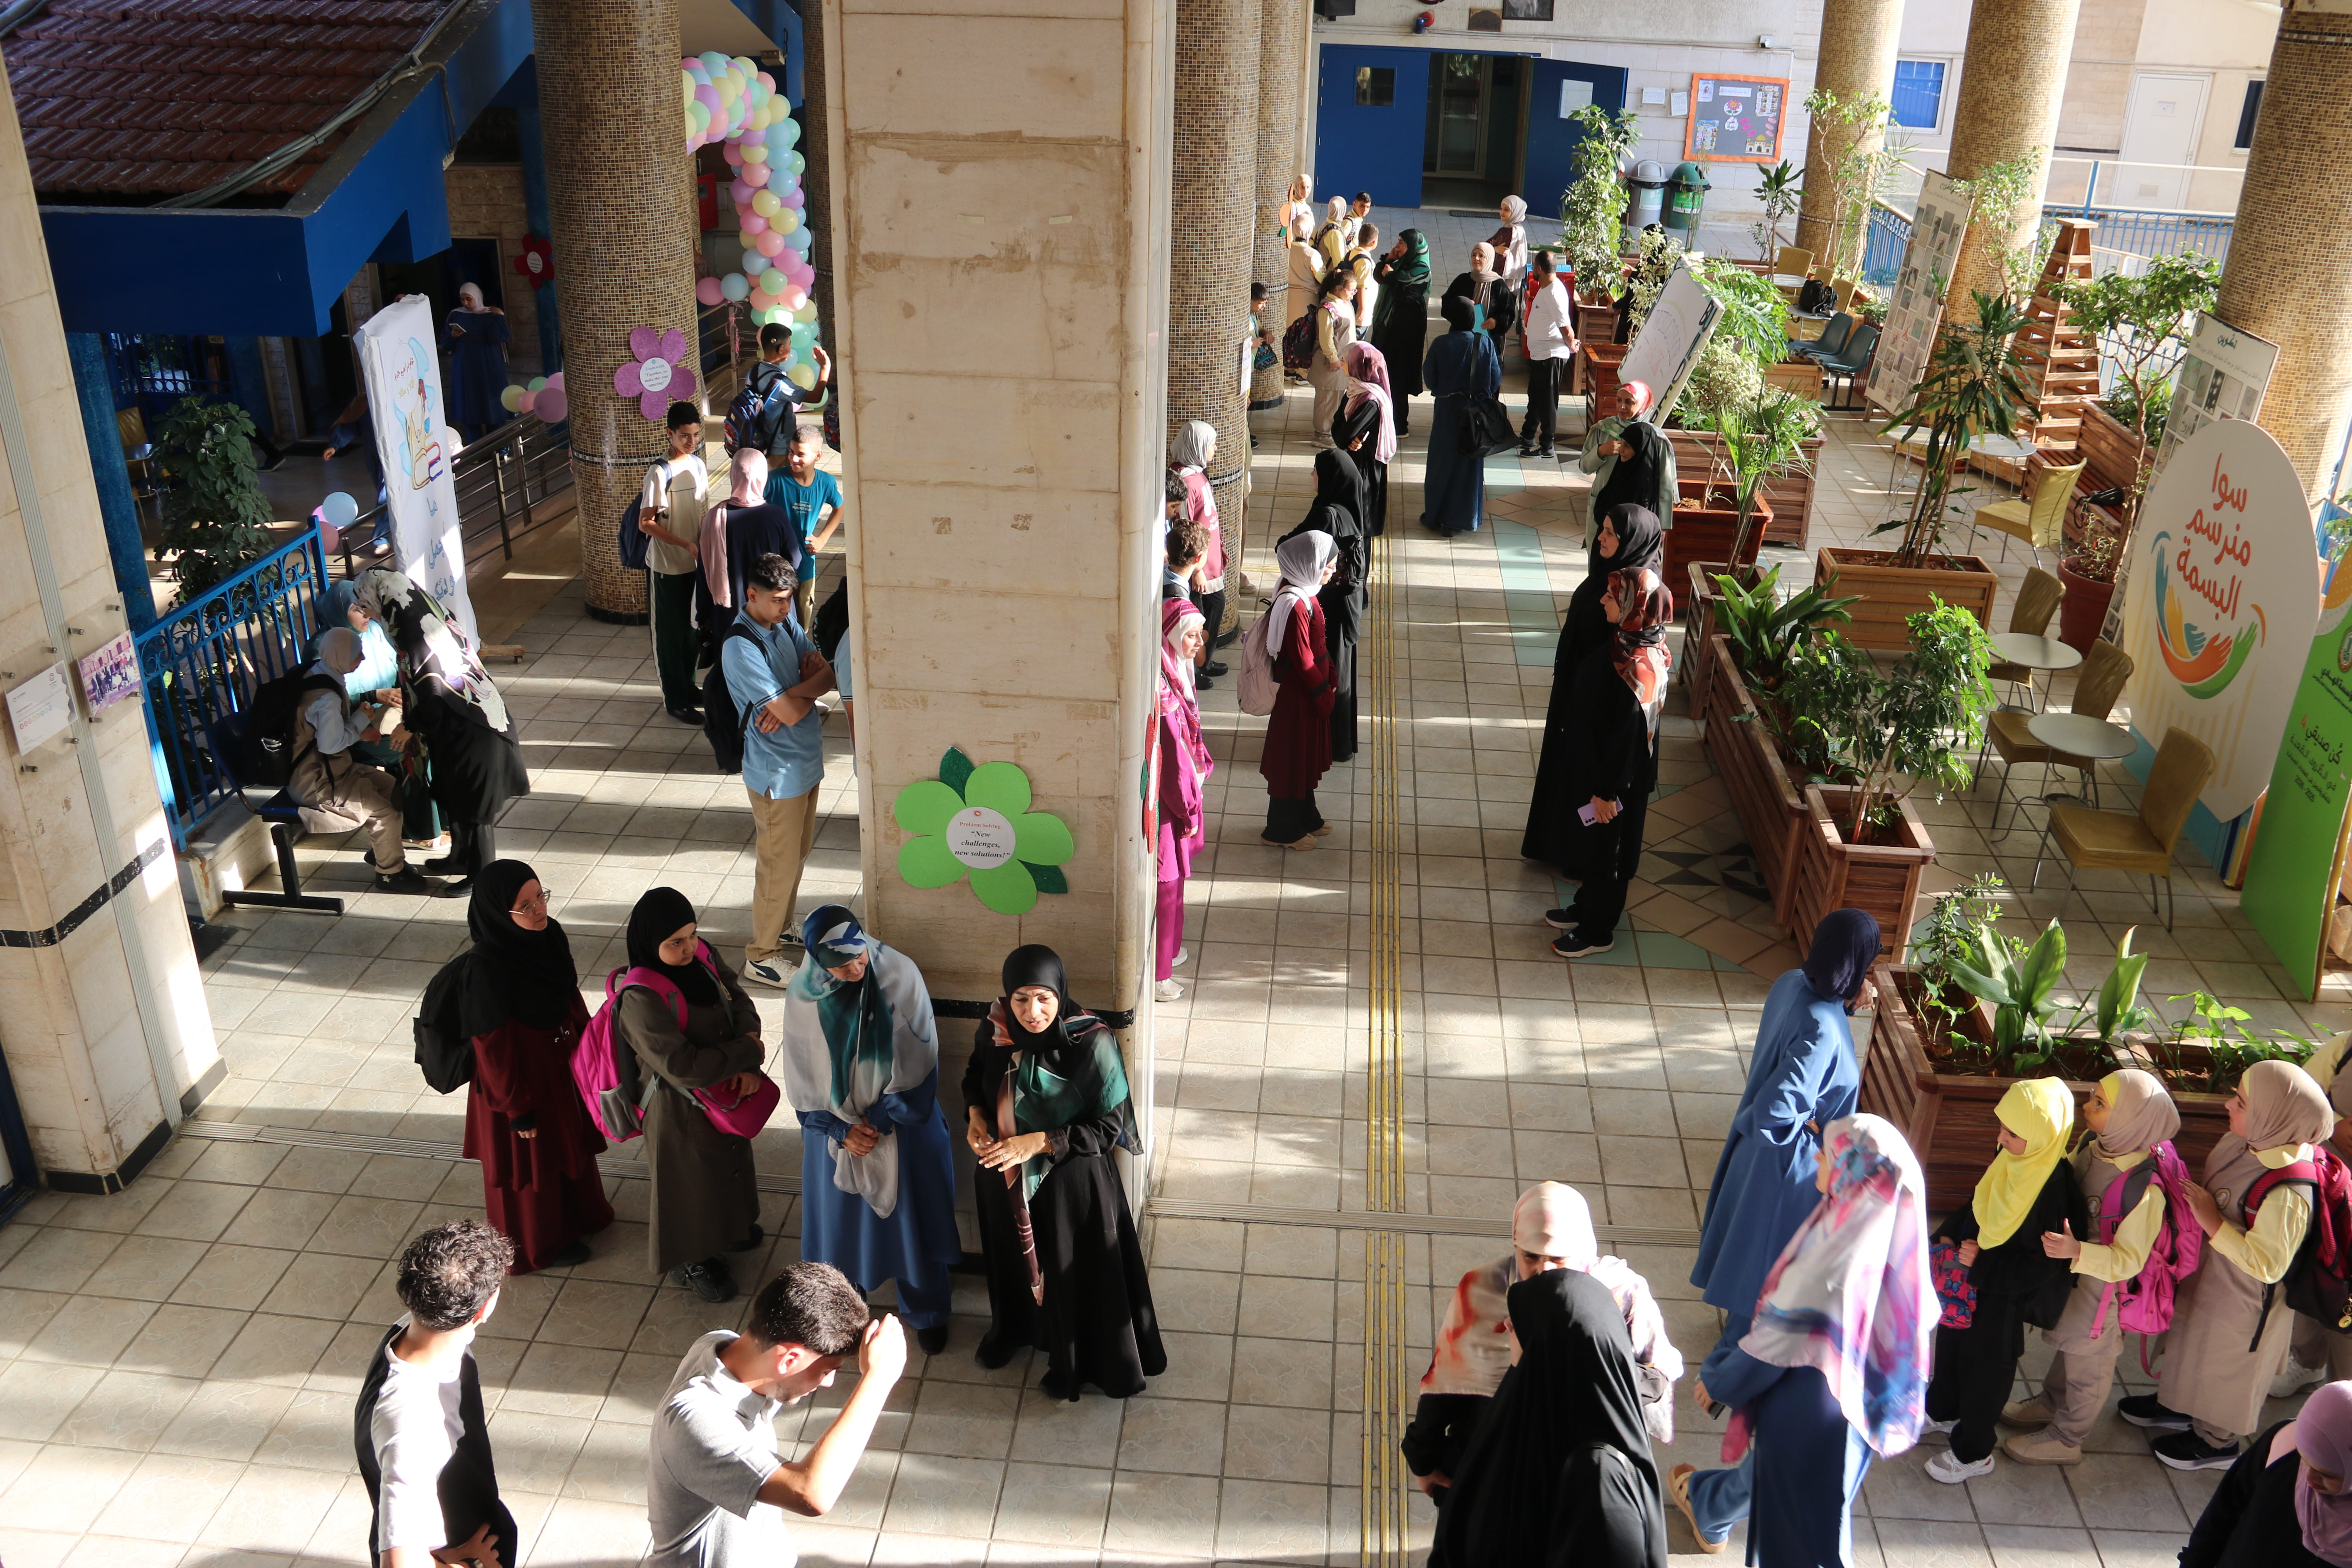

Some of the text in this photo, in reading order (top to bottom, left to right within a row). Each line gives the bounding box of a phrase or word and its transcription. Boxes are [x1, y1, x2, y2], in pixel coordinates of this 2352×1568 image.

[2212, 452, 2247, 512] سوا
[426, 497, 438, 517] ما
[2185, 509, 2251, 567] منرسم
[2177, 535, 2242, 621] البسمة
[2305, 726, 2329, 752] صديقي
[961, 840, 1000, 848] challenges,
